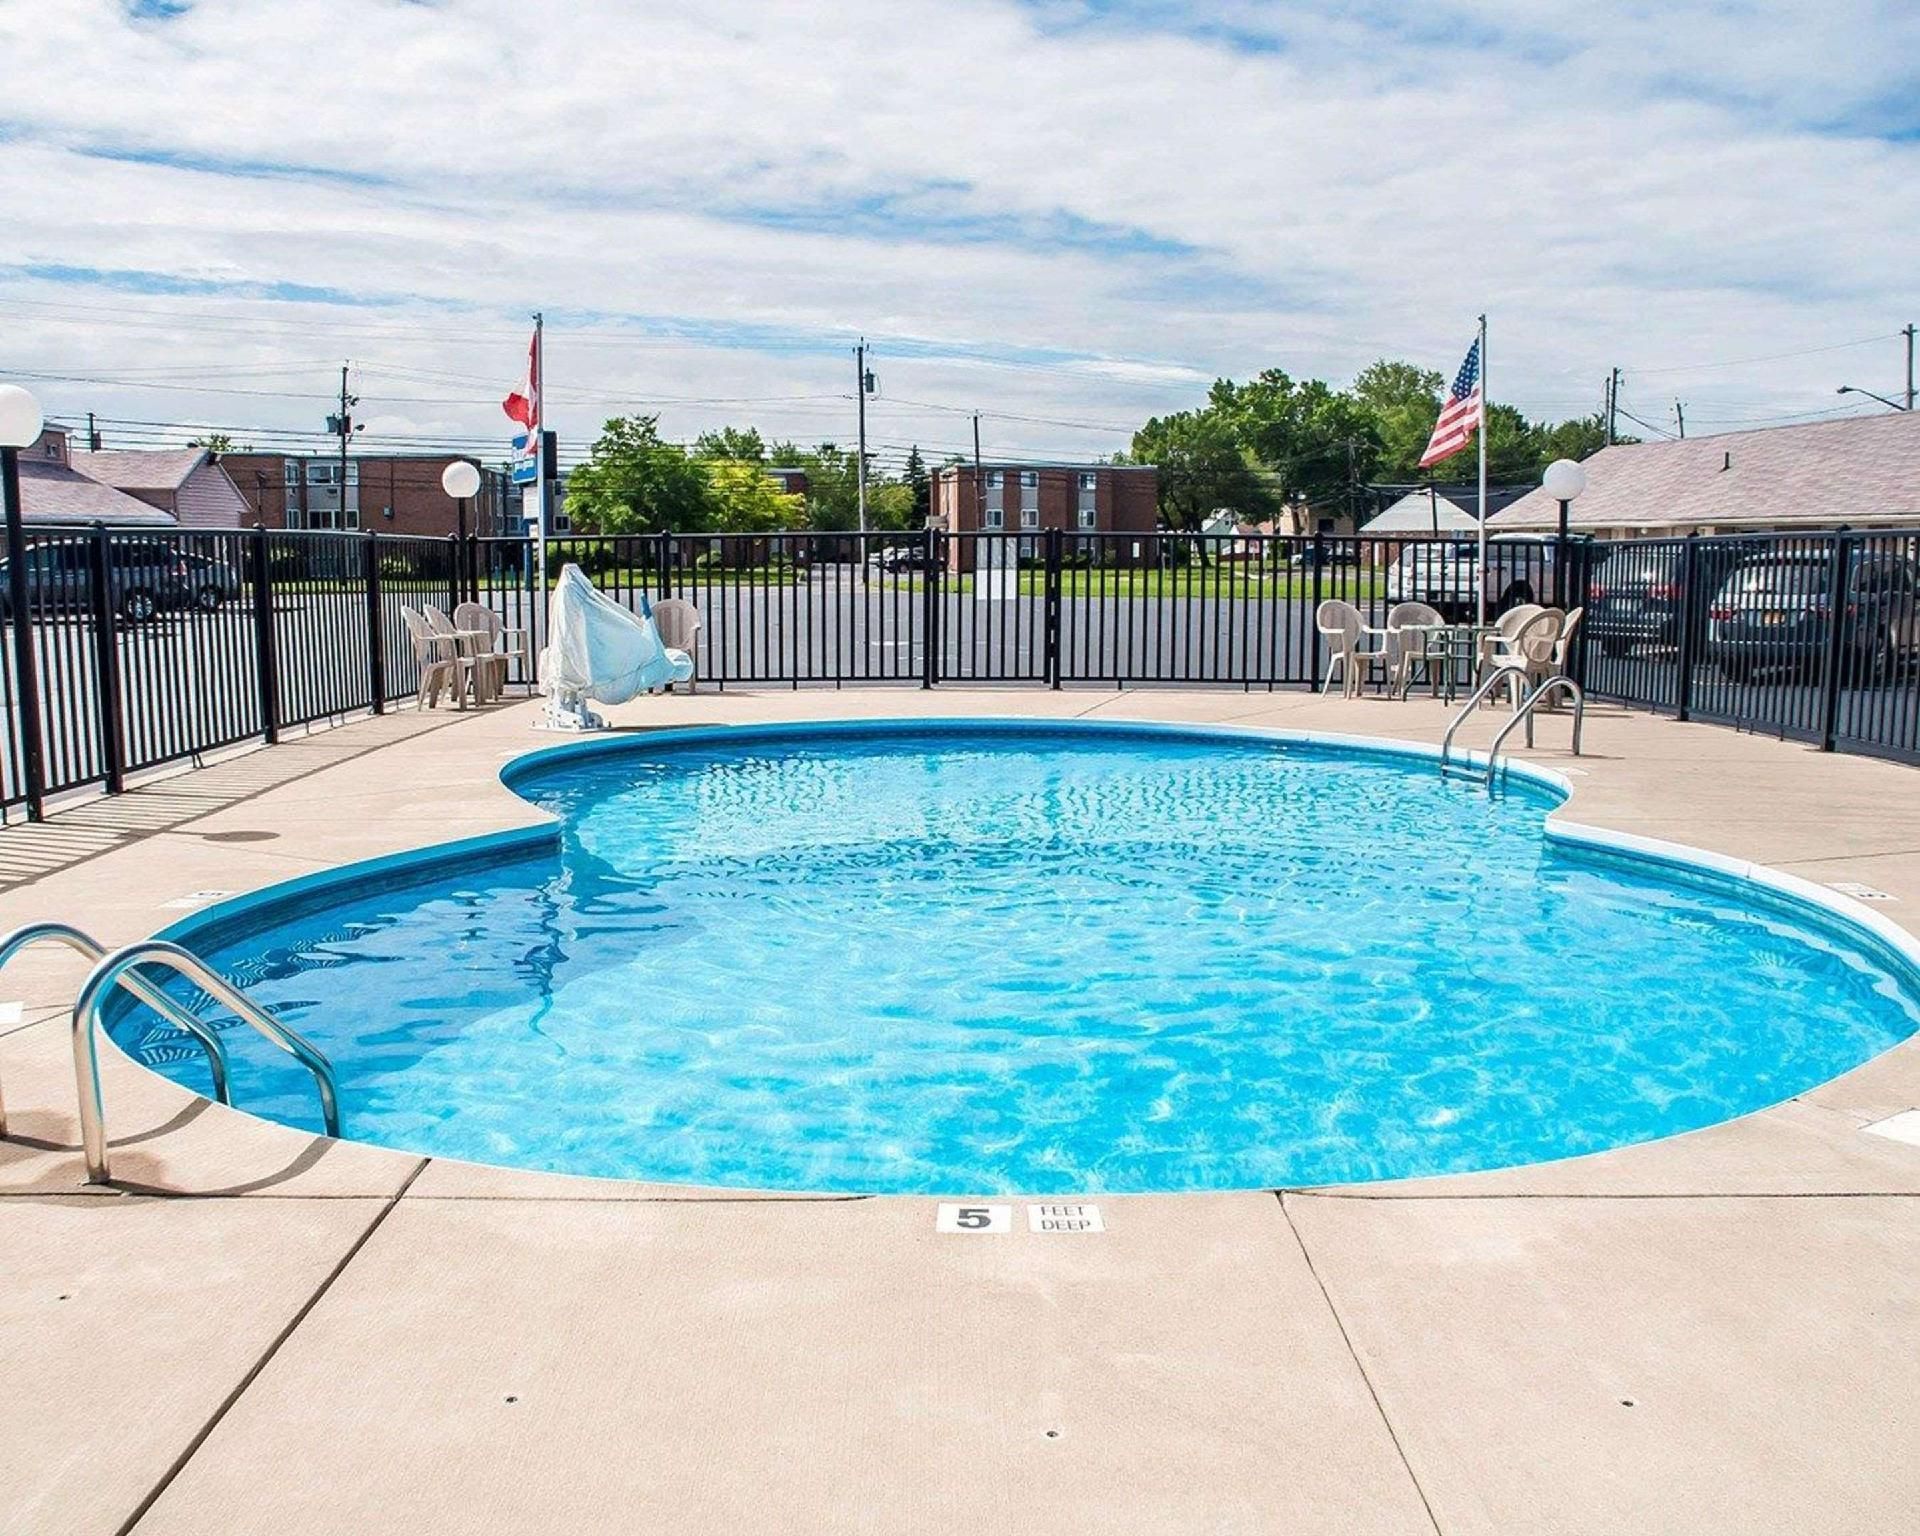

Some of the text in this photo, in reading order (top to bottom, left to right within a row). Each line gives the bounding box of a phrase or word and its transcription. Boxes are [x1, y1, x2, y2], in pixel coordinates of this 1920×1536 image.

[1040, 1206, 1085, 1216] FEET
[957, 1208, 992, 1229] 5
[1041, 1219, 1091, 1231] DEEP
